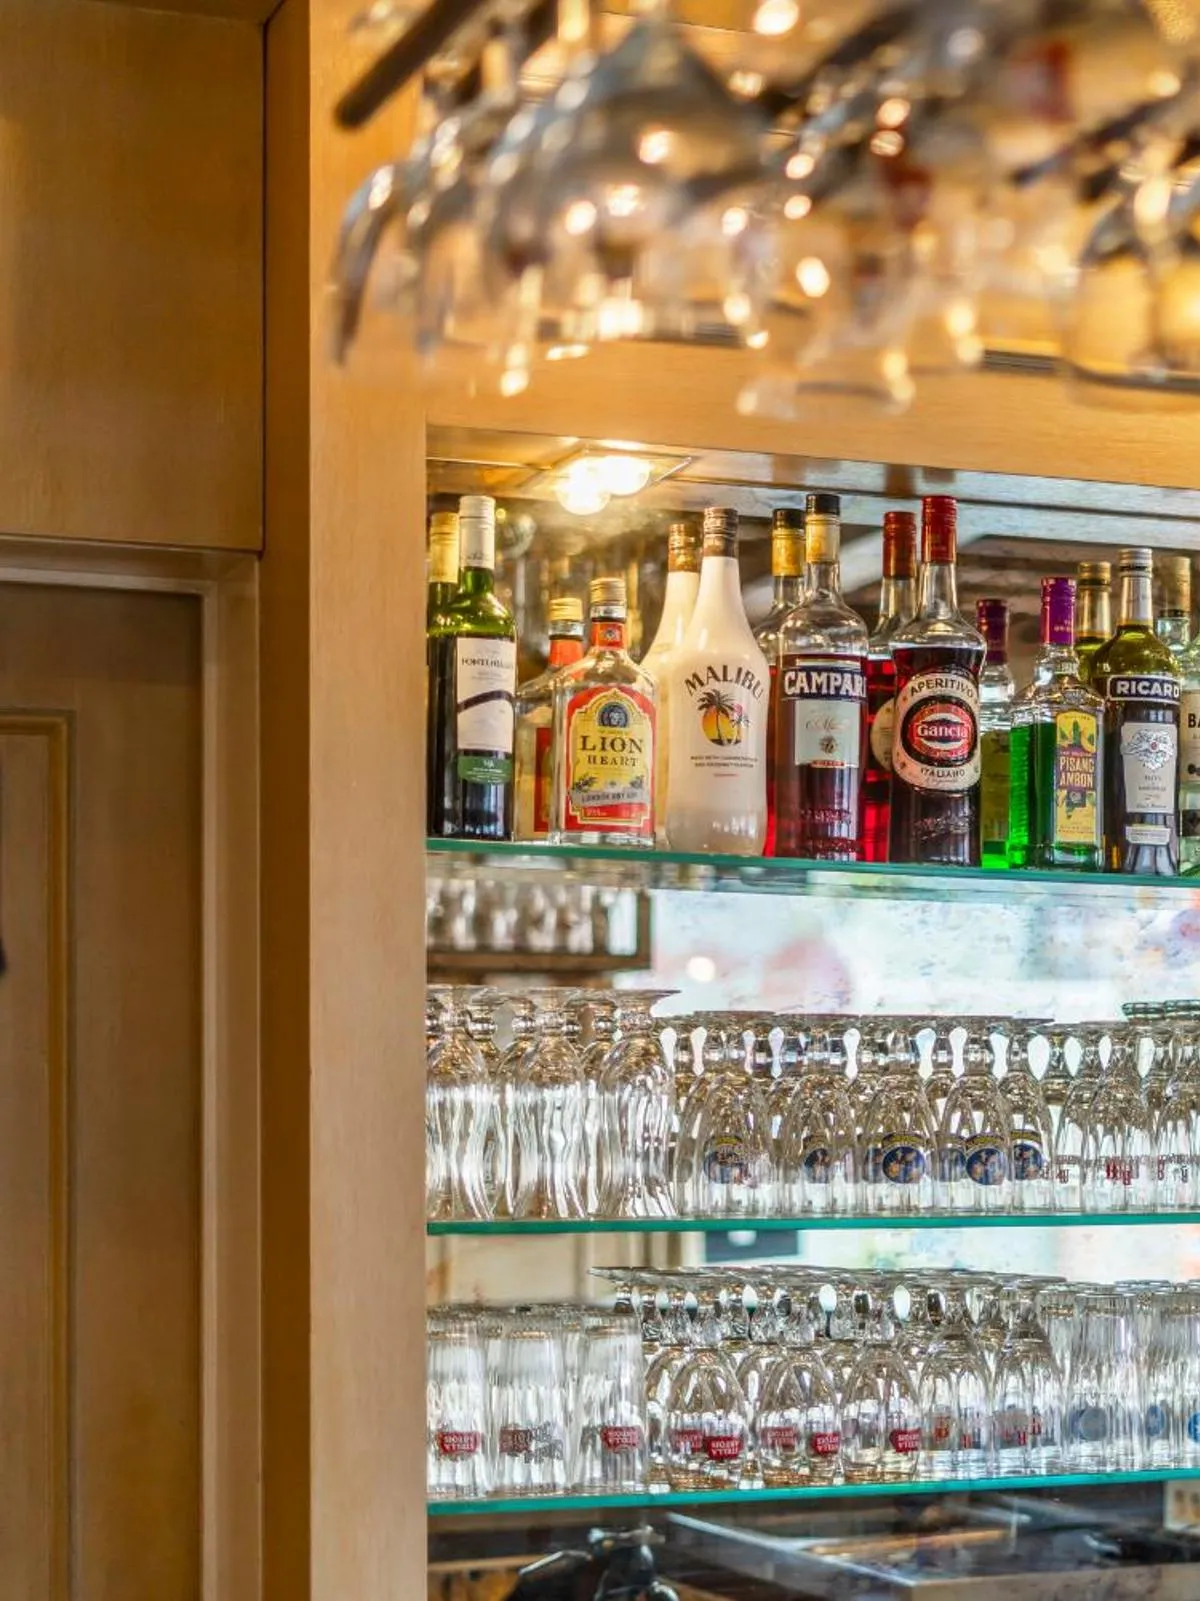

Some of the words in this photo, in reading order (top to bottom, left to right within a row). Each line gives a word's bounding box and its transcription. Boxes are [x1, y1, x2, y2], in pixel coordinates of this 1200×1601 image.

[684, 664, 764, 700] MALIBU
[784, 671, 867, 698] CAMPARI
[910, 677, 974, 698] APERITIVO
[1116, 680, 1180, 698] RICARD
[916, 723, 969, 738] Gancia
[579, 735, 643, 753] LION
[587, 755, 638, 767] HEART
[1059, 755, 1095, 773] PISANG
[920, 767, 966, 779] ITALIANO
[1059, 772, 1094, 788] AMBON
[711, 1440, 739, 1448] ARTOIS
[711, 1447, 739, 1455] STELLA
